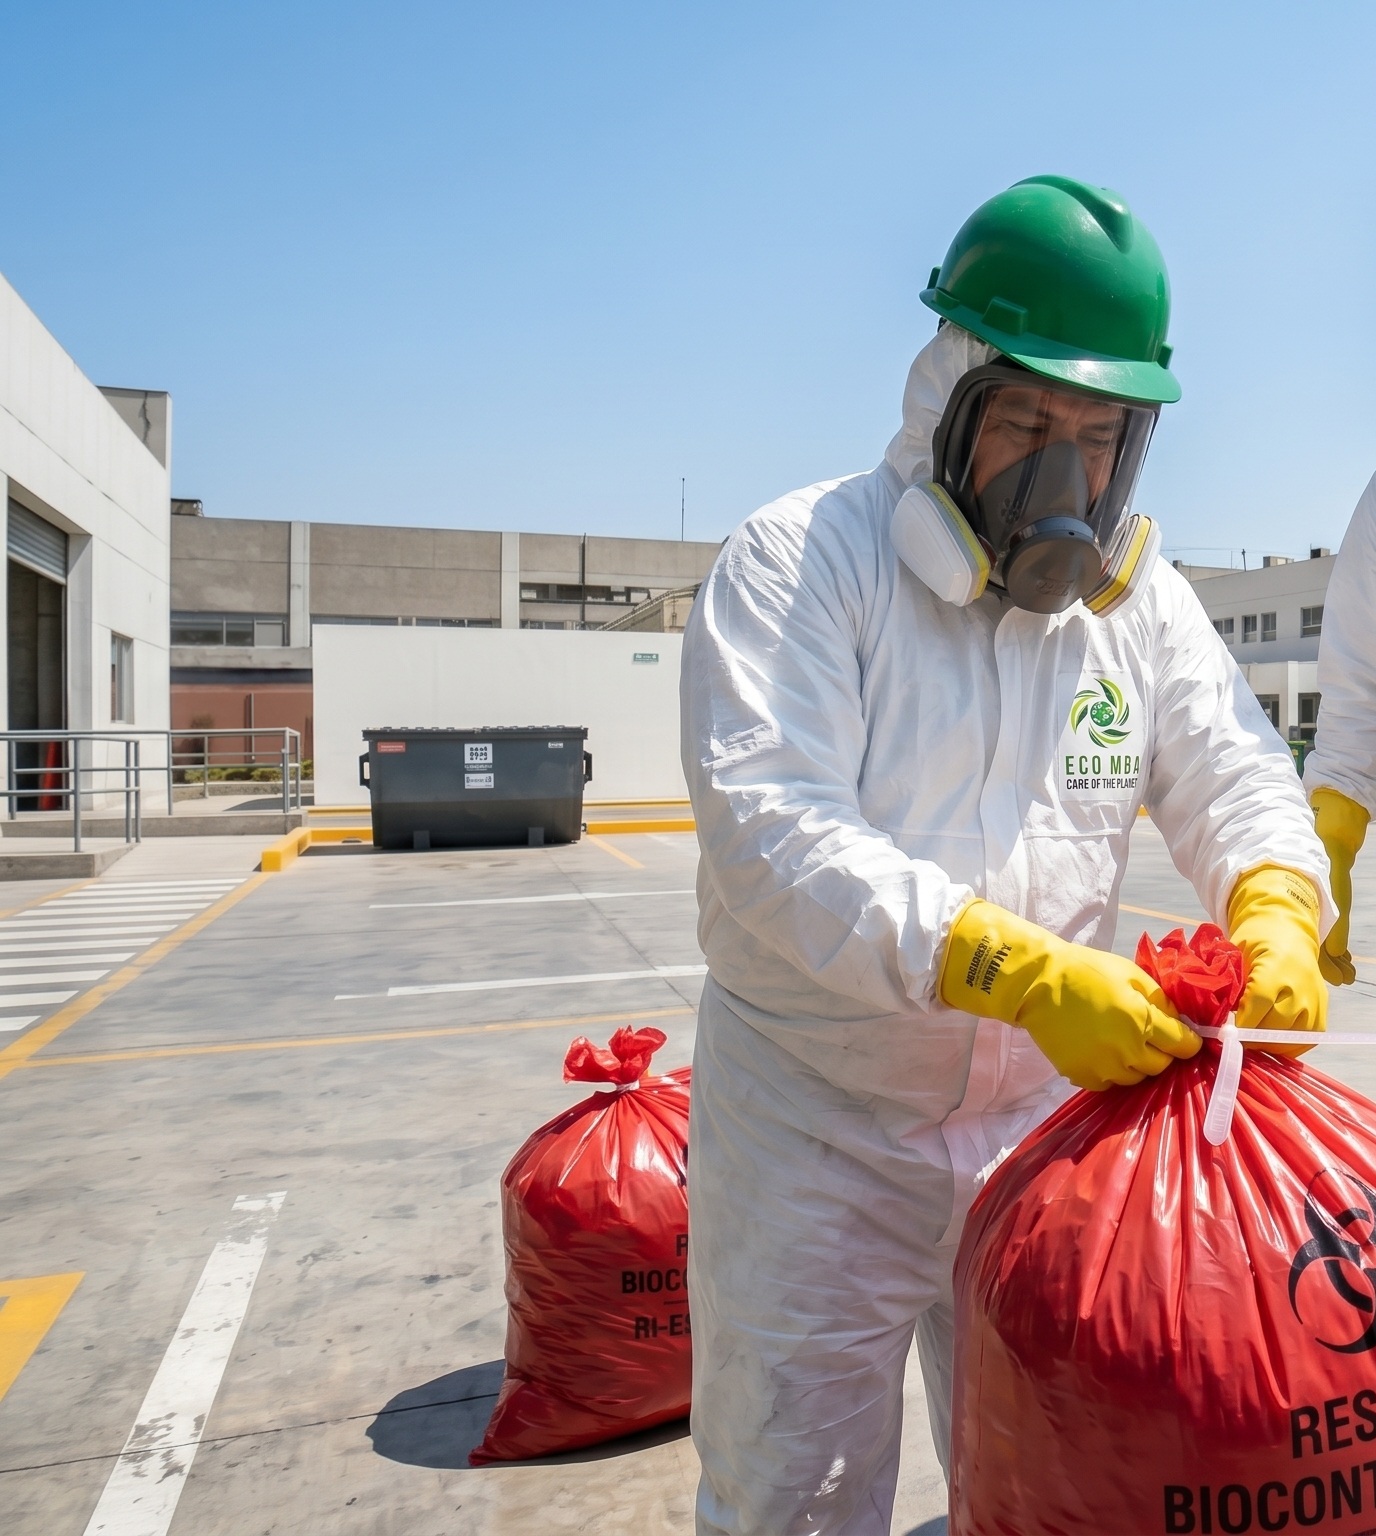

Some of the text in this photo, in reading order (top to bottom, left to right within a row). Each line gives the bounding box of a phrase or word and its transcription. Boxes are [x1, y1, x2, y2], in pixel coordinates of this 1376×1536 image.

[1065, 755, 1140, 776] ECO MBA
[1066, 777, 1138, 790] CARE OF THE PLANET
